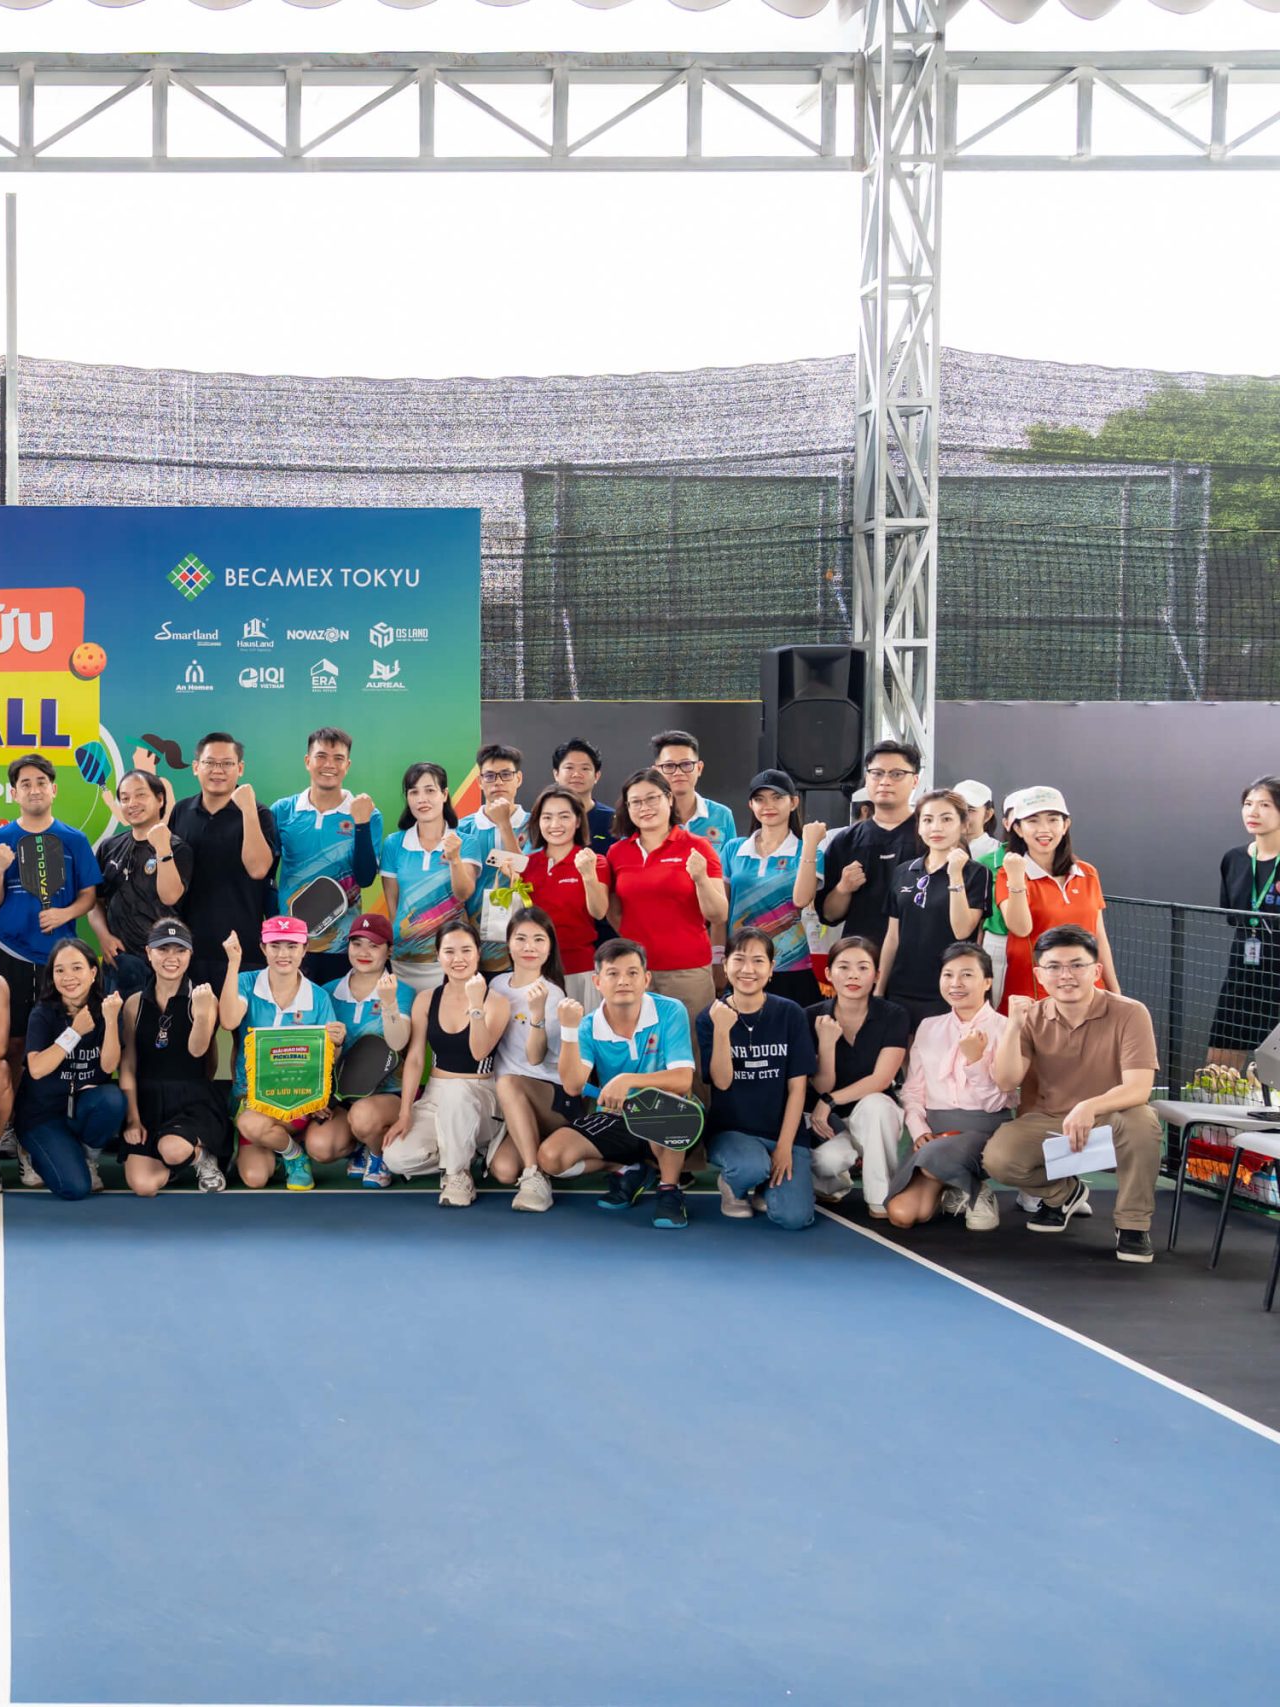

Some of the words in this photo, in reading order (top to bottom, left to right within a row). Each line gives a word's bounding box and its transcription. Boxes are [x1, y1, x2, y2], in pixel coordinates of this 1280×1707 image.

[225, 568, 334, 587] BECAMEX
[340, 568, 420, 587] TOKYU
[154, 621, 219, 640] Smartland
[408, 628, 429, 638] LAND
[237, 640, 274, 648] HausLand
[260, 667, 284, 683] IQI
[312, 676, 337, 686] ERA
[35, 835, 48, 896] FACOLOS
[734, 1070, 755, 1080] NEW
[758, 1068, 780, 1080] CITY
